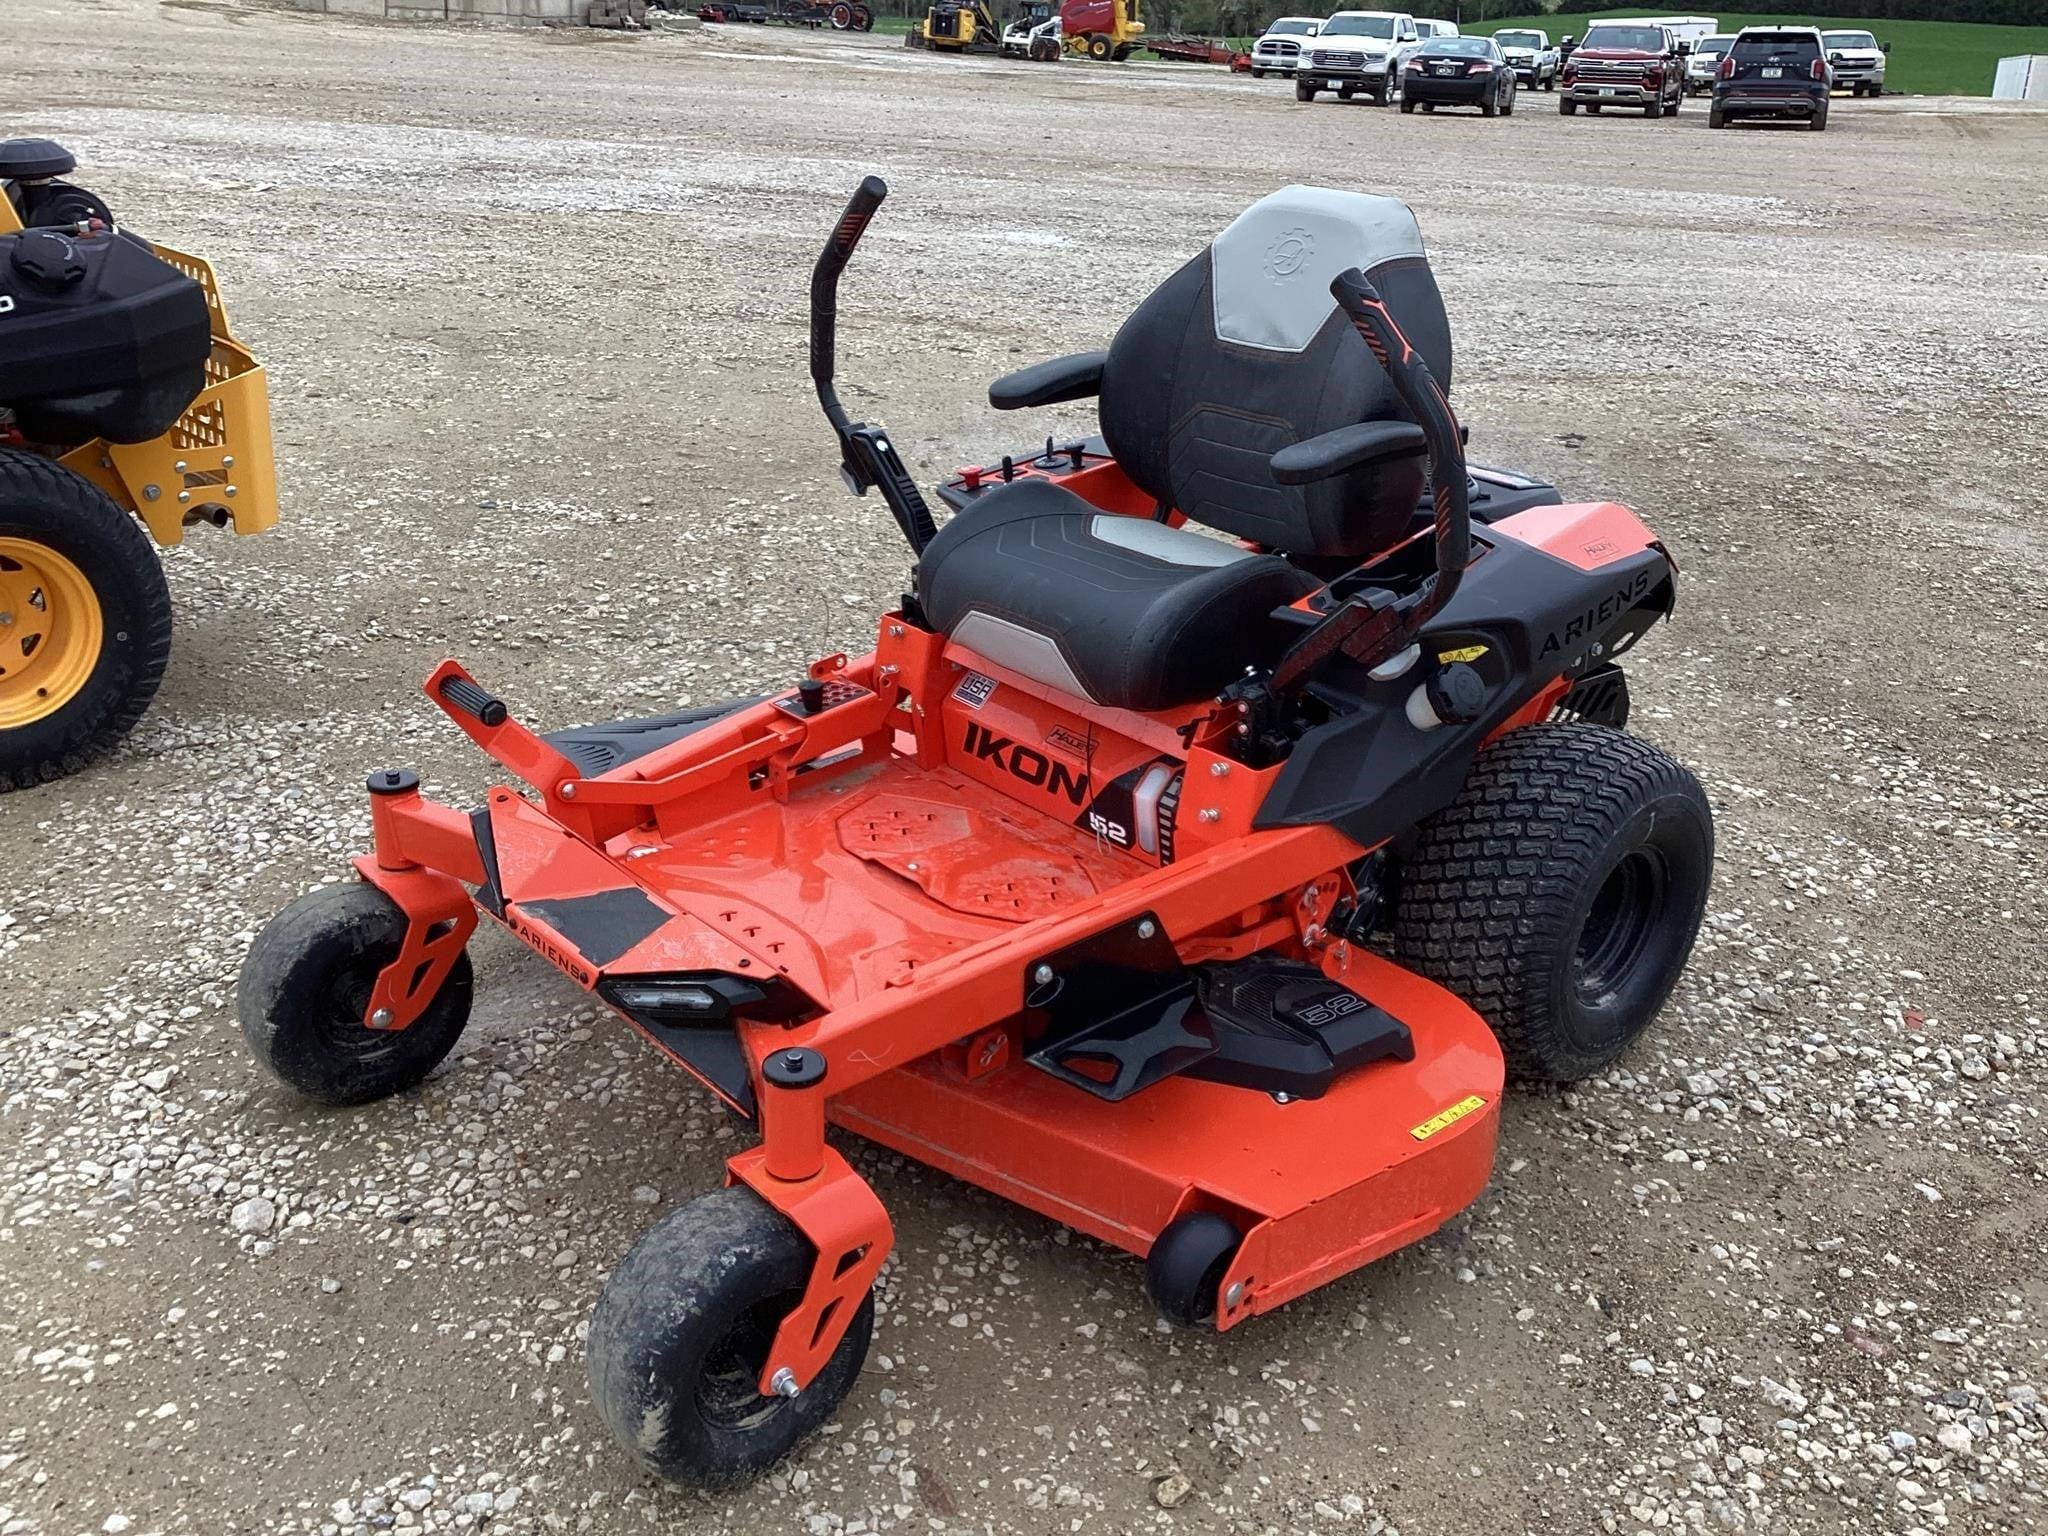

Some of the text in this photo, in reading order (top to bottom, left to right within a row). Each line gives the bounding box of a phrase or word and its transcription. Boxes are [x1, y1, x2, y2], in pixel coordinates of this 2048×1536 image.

[1539, 569, 1648, 660] ARIENS
[961, 676, 992, 699] USA
[962, 720, 1089, 806] IKON
[1088, 811, 1128, 845] 52
[520, 926, 580, 980] ARIENS
[1295, 993, 1367, 1026] 52
